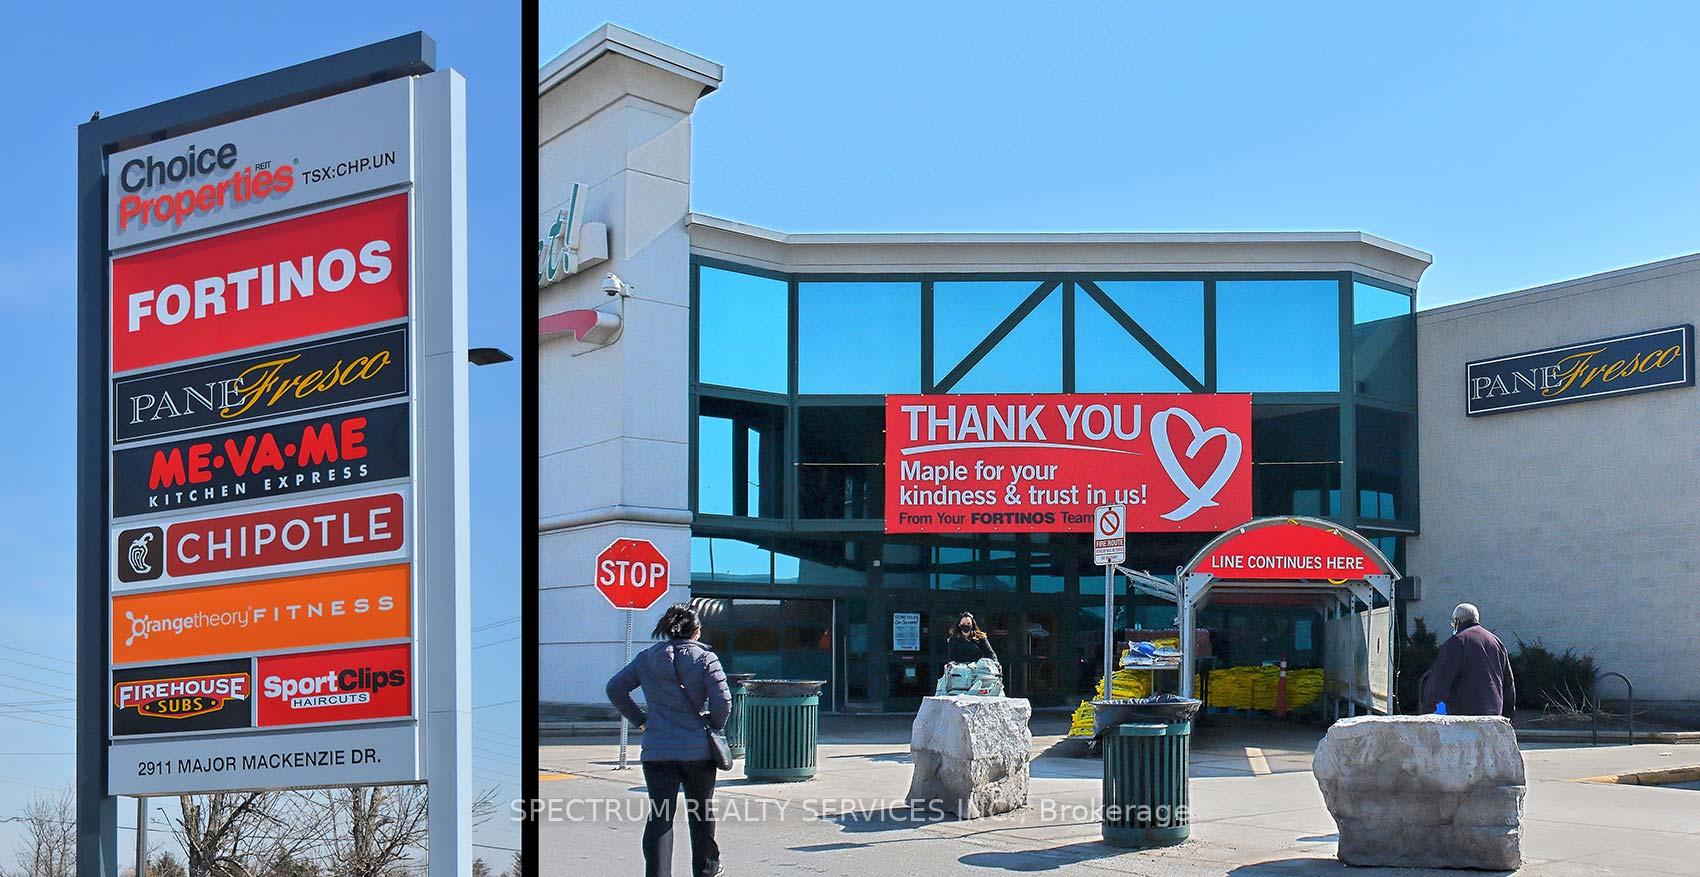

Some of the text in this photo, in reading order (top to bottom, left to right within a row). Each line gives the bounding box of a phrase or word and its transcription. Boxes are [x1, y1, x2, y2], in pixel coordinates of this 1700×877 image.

[120, 142, 238, 193] Choice
[255, 160, 272, 172] REIT
[302, 151, 396, 185] TSX:CHP.UN
[119, 165, 294, 231] Properties
[128, 240, 393, 332] FORTINOS
[129, 350, 391, 425] PANE Fresco
[1471, 345, 1682, 400] PANE Fresco
[901, 404, 1143, 441] THANK YOU
[149, 464, 369, 508] KITCHEN EXPRESS
[900, 460, 1058, 485] Maple for your
[900, 484, 1148, 506] kindness & trust in us!
[899, 512, 1094, 525] From Your FORTINOS Team
[177, 507, 392, 564] CHIPOTLE
[600, 559, 665, 588] STOP
[1212, 555, 1364, 570] LINE CONTINUES HERE
[253, 596, 394, 623] FITNESS
[119, 677, 245, 710] FIREHOUSE
[158, 697, 203, 713] SUBS
[293, 693, 368, 708] HAIRCUTS
[138, 748, 381, 776] 2911 MAJOR MACKENZIE DR.
